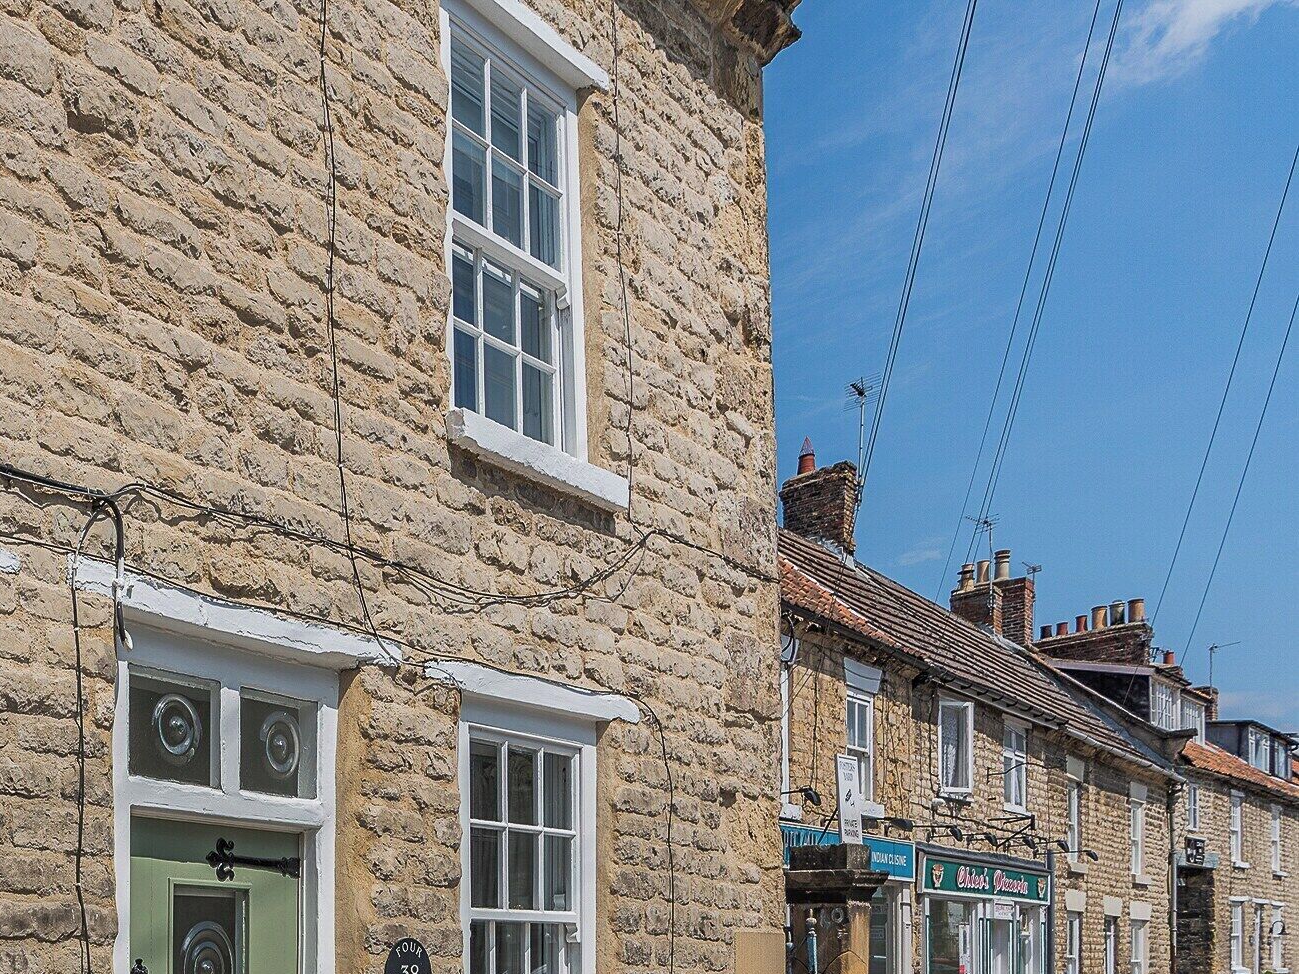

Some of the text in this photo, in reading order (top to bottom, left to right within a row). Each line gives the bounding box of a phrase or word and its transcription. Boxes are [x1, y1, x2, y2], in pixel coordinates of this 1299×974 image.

[871, 851, 907, 867] INDIAN CUISINE
[957, 866, 1028, 894] Chico's Pizzeria
[396, 942, 422, 958] FOUR
